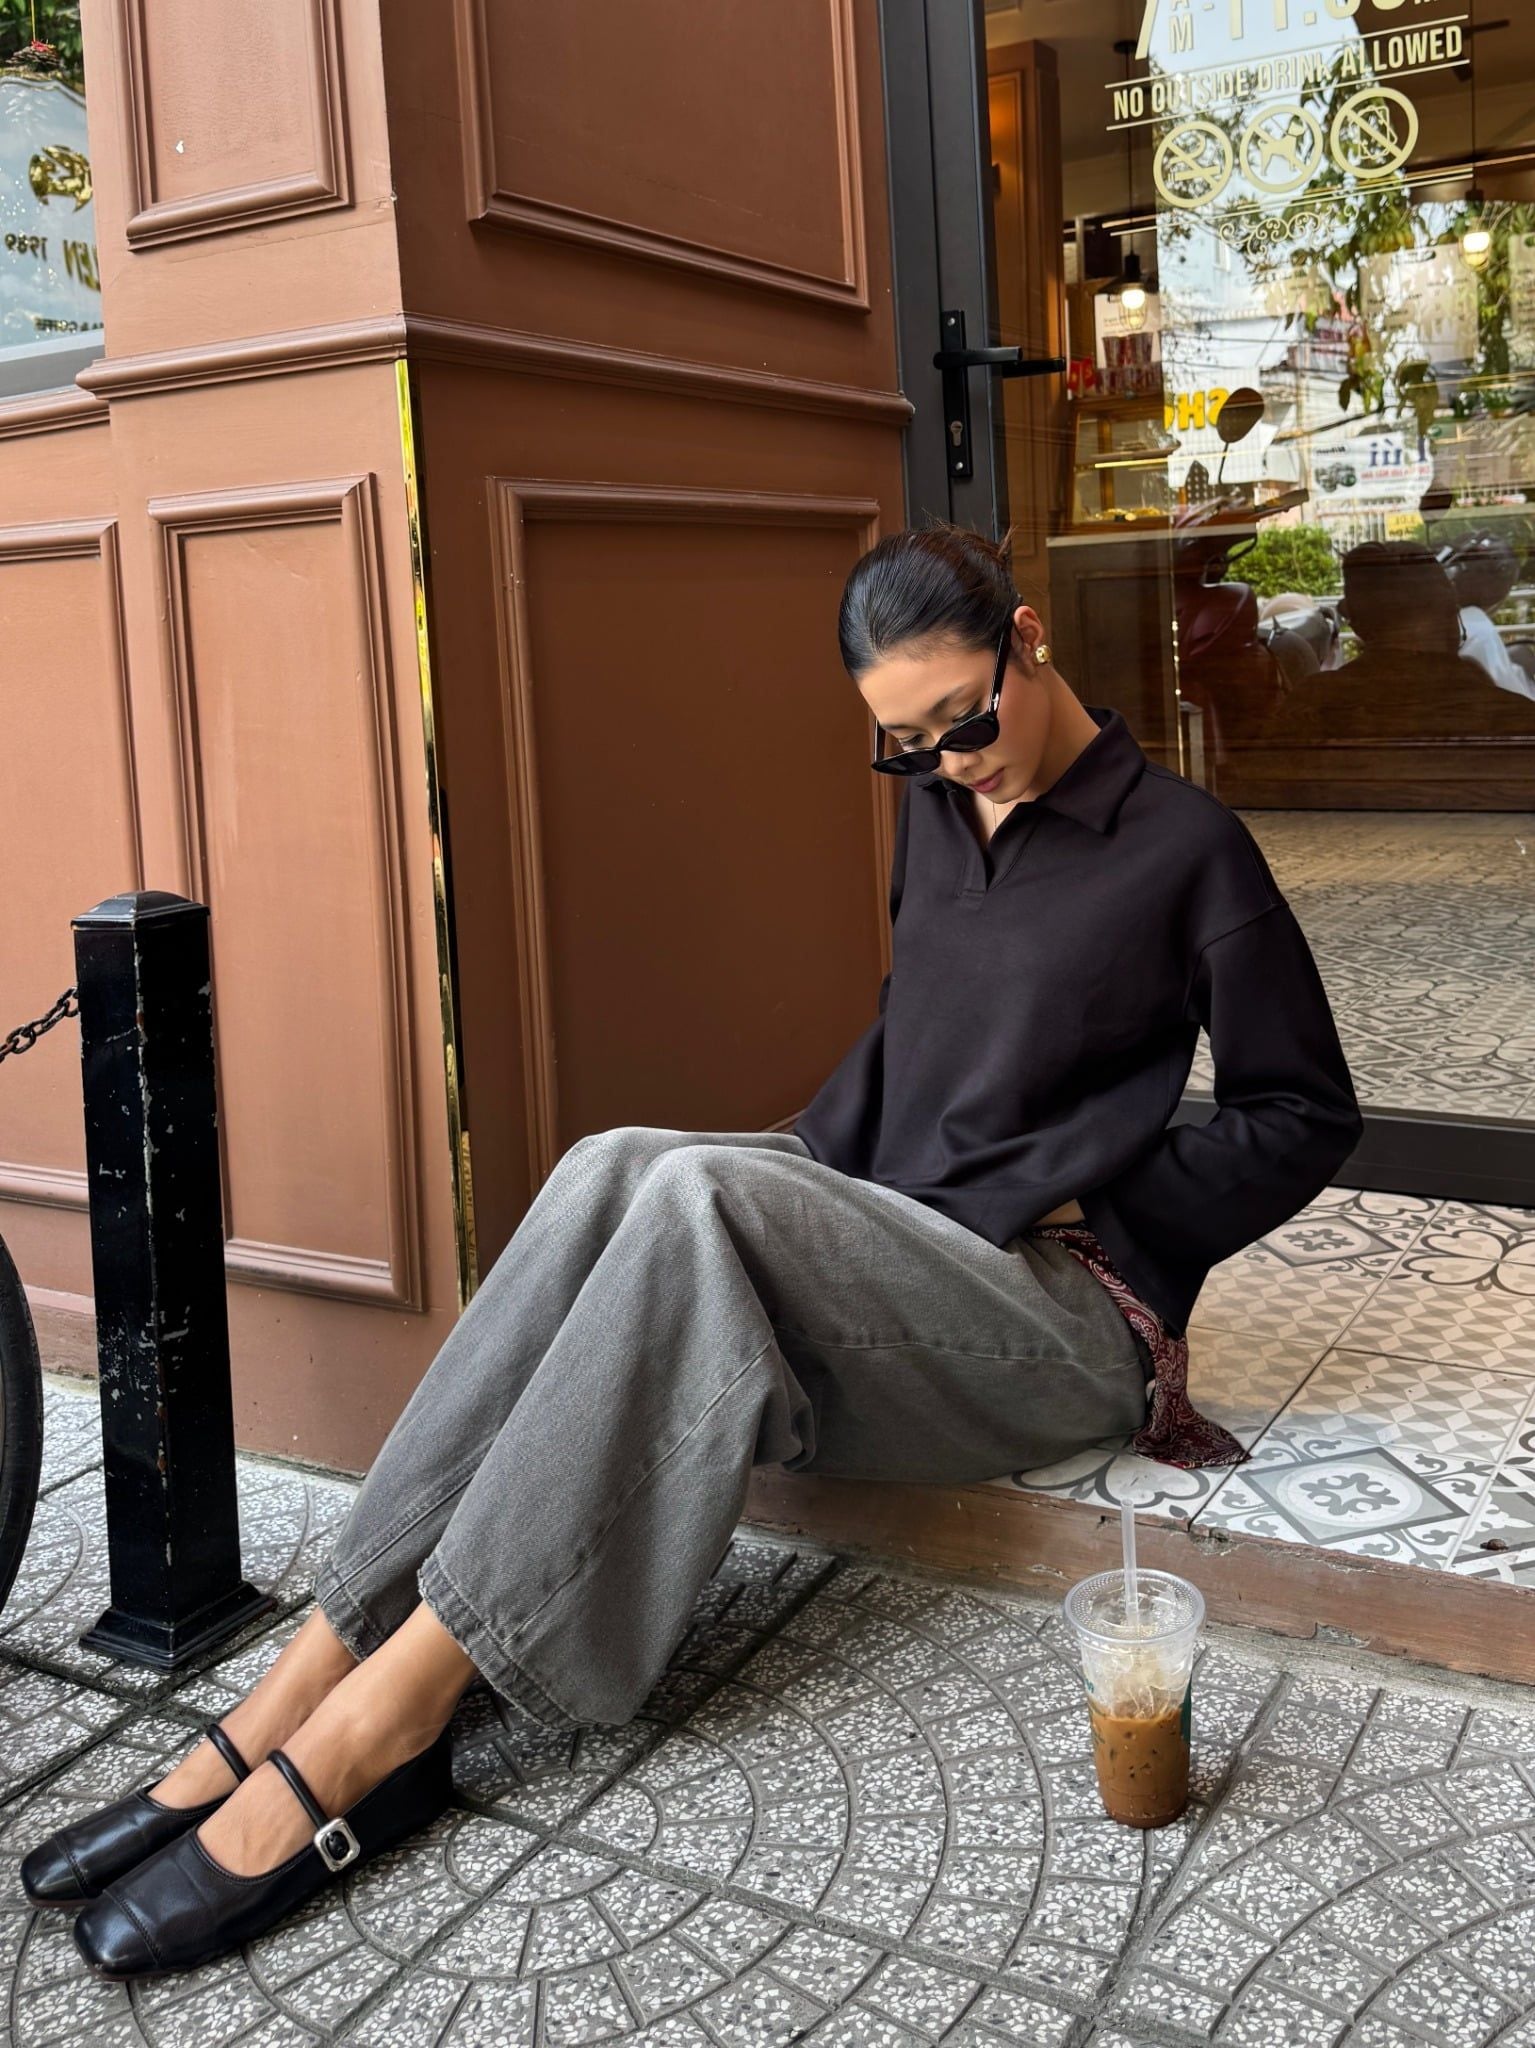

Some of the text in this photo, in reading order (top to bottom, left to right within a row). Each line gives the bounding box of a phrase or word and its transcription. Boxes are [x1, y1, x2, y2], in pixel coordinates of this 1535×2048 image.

[1113, 25, 1463, 121] NO OUTSIDE DRINK ALLOWED
